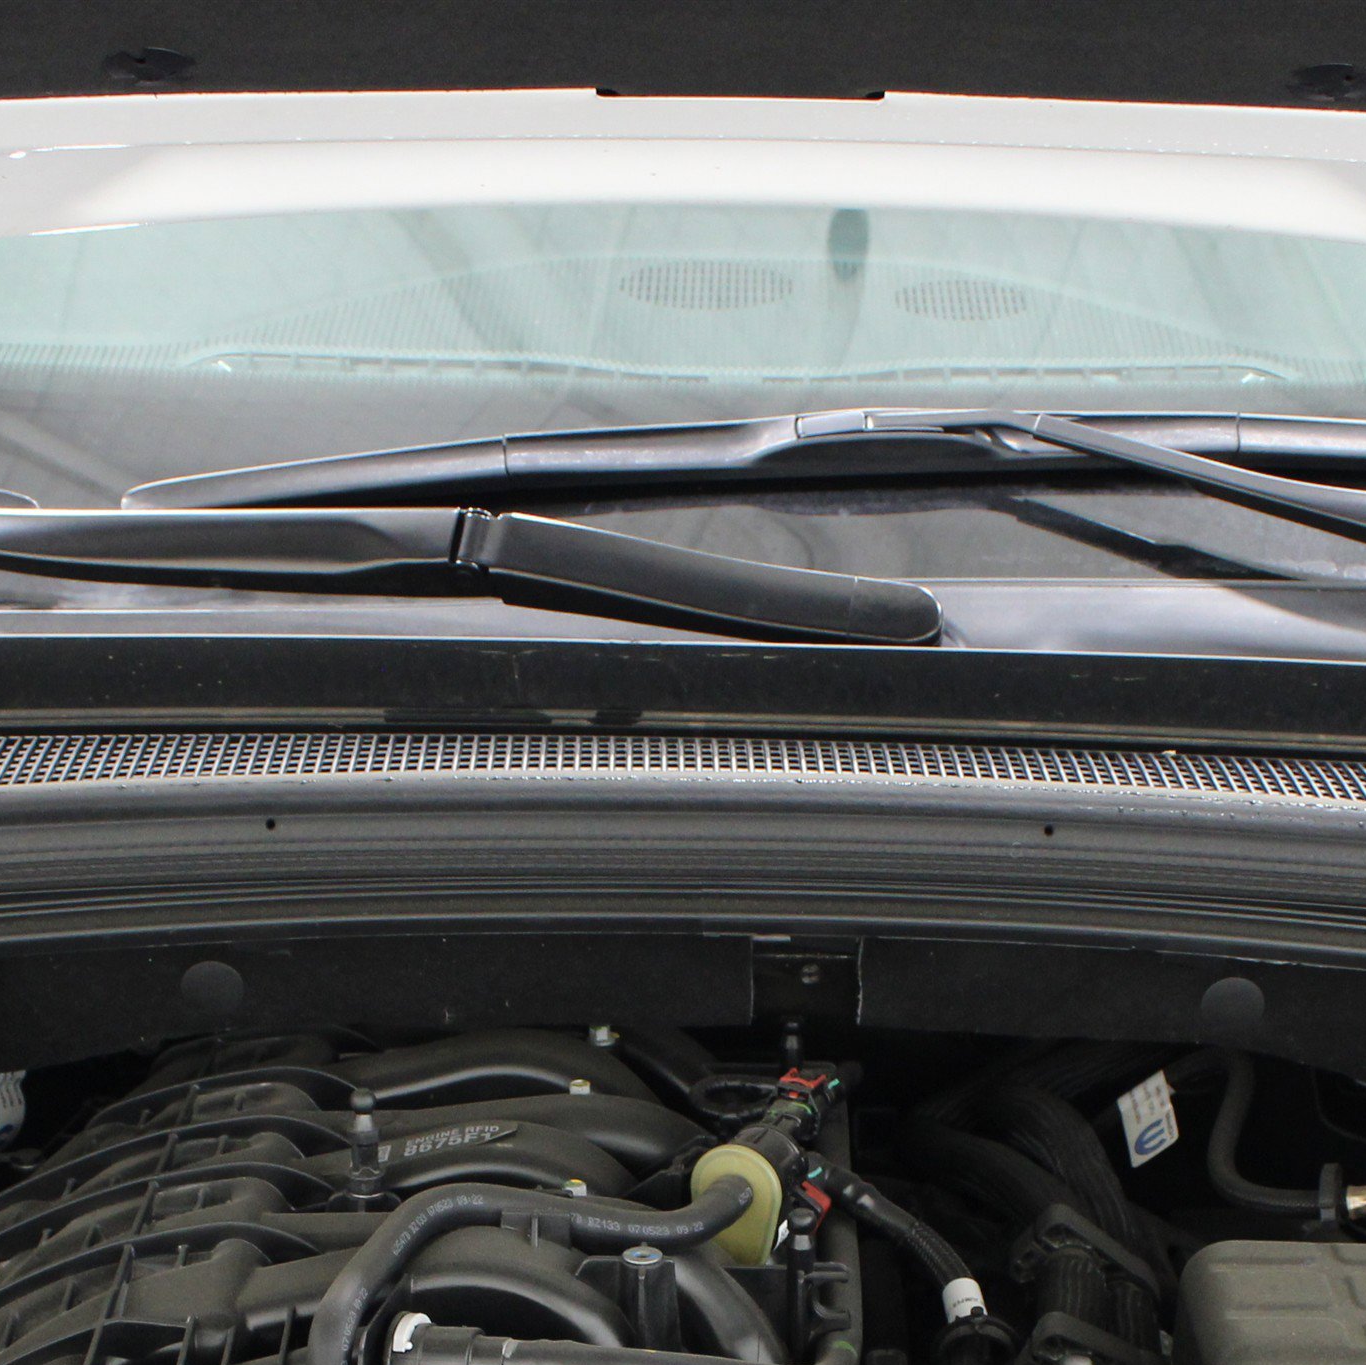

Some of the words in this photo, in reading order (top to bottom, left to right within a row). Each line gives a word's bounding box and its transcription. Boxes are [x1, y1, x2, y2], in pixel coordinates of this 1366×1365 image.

[406, 1128, 459, 1147] ENGINE
[465, 1125, 499, 1134] RFID
[628, 1225, 670, 1236] 070523
